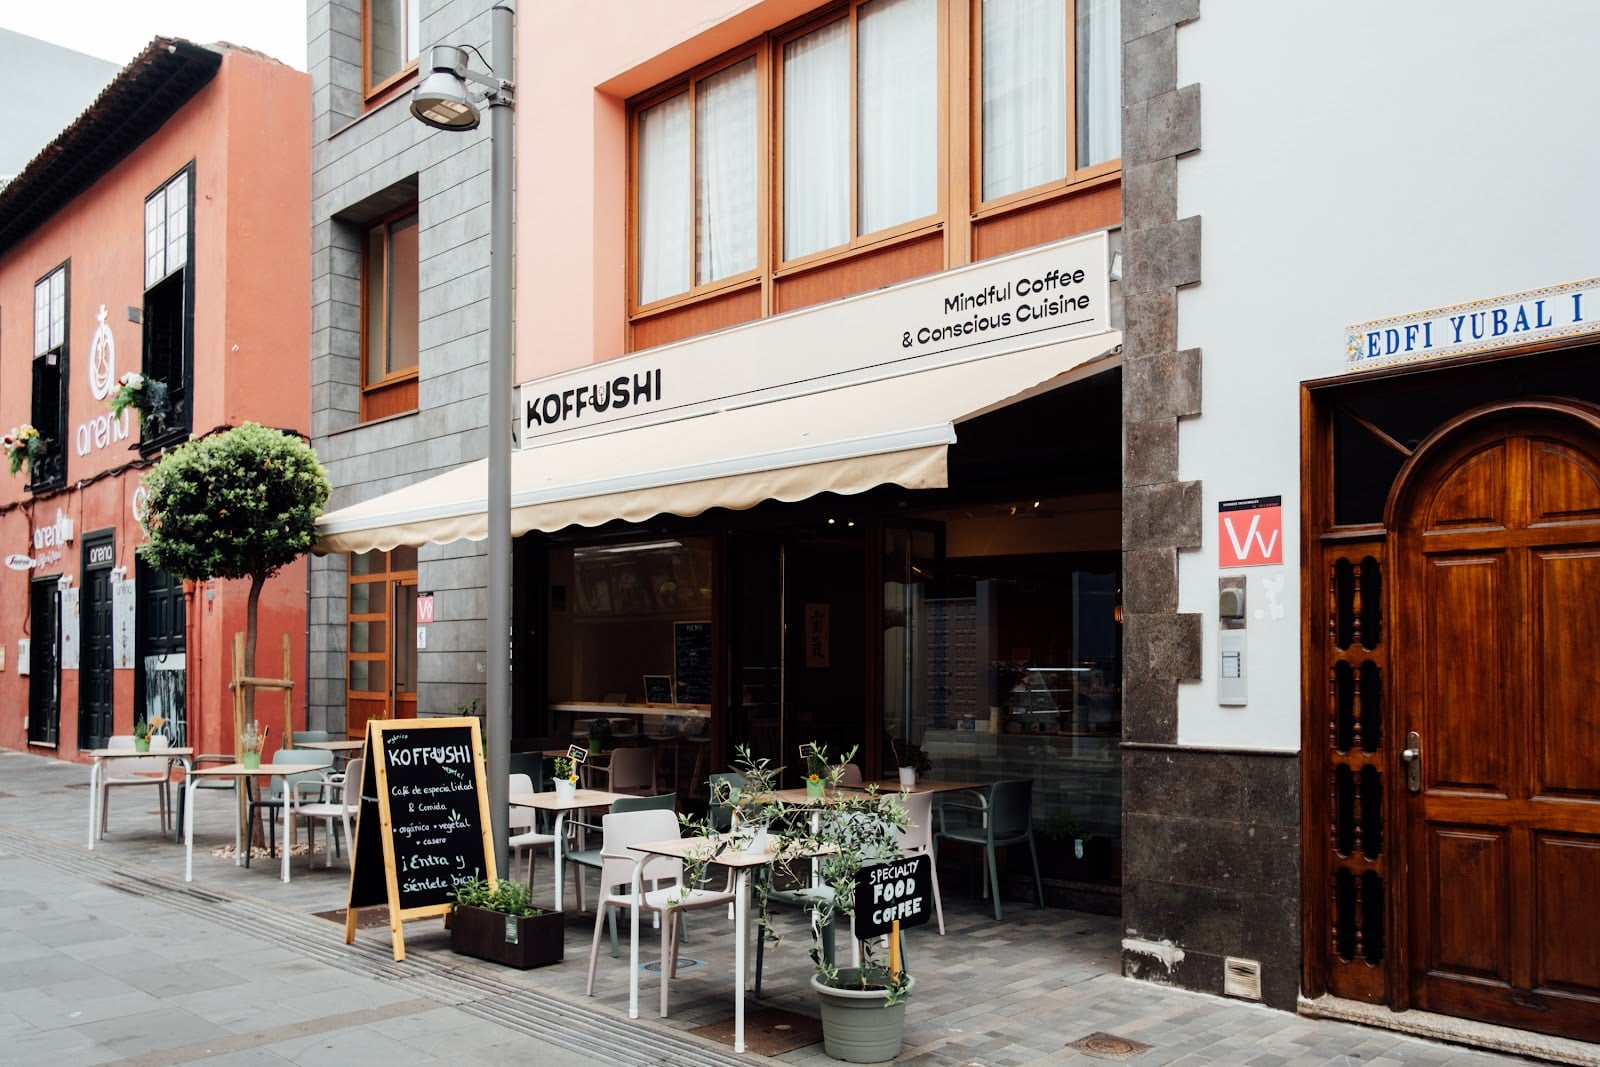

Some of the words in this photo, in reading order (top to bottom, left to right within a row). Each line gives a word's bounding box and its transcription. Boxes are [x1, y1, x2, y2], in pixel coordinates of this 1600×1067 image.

[944, 281, 1011, 315] Mindful
[1016, 269, 1085, 297] Coffee
[902, 331, 913, 348] &
[917, 312, 1011, 345] Conscious
[1016, 294, 1090, 323] Cuisine
[1367, 321, 1433, 359] EDFI
[1450, 300, 1552, 344] YUBAL
[1572, 293, 1583, 322] I
[527, 368, 661, 428] KOFFUSHI
[77, 408, 129, 456] arena
[91, 545, 112, 563] arena
[388, 745, 471, 767] KOFFUSHI
[391, 785, 409, 797] Café
[412, 785, 422, 795] de
[408, 802, 415, 813] &
[418, 802, 447, 812] Comida
[399, 822, 430, 838] orgánico
[439, 818, 471, 834] vegetal
[423, 837, 446, 846] casero
[456, 855, 466, 870] y
[869, 860, 919, 885] SPECIALTY
[403, 877, 448, 893] siéntete
[873, 878, 916, 905] FOOD
[872, 897, 922, 925] COFFEE
